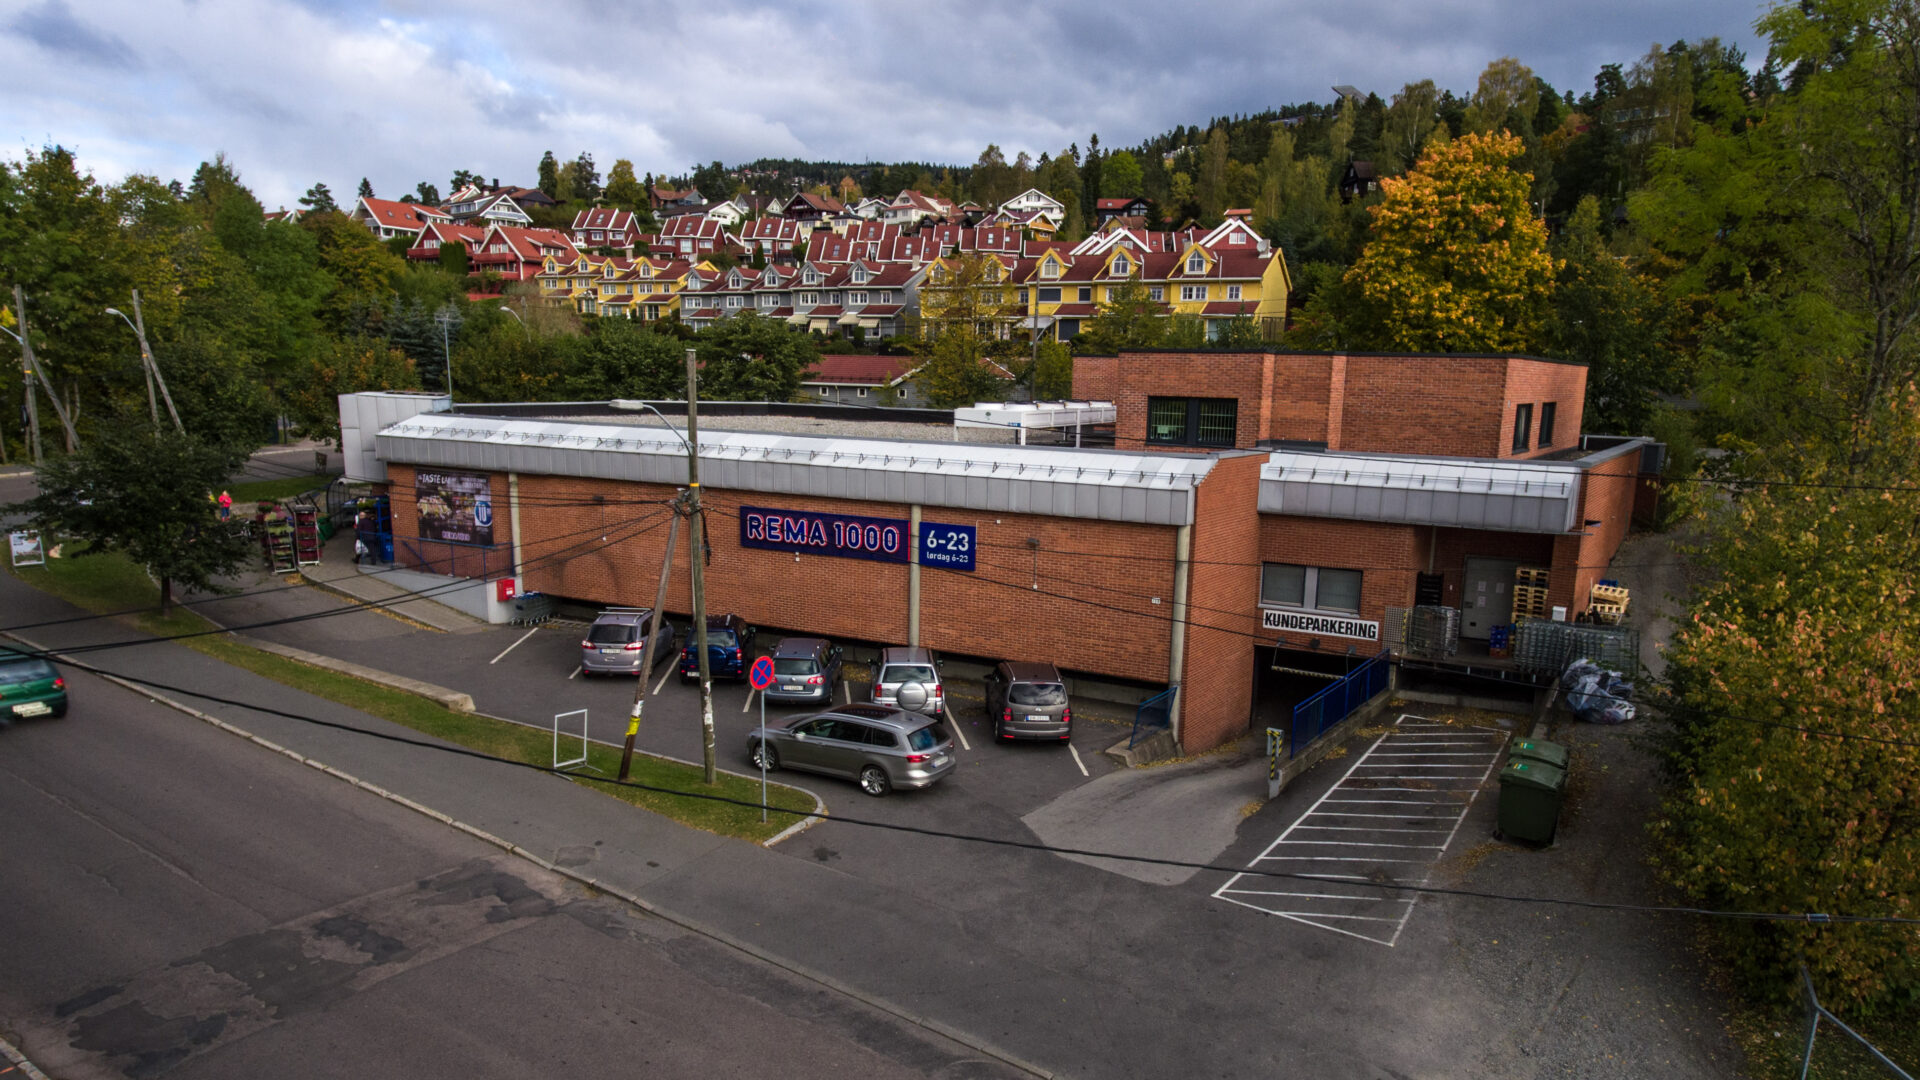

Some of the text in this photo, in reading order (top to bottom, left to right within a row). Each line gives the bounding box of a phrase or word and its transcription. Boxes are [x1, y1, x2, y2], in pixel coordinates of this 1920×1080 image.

[747, 514, 900, 553] REMA 1000
[926, 530, 969, 552] 6-23
[926, 551, 969, 563] lørdag 6-23
[1264, 611, 1378, 639] KUNDEPARKERING
